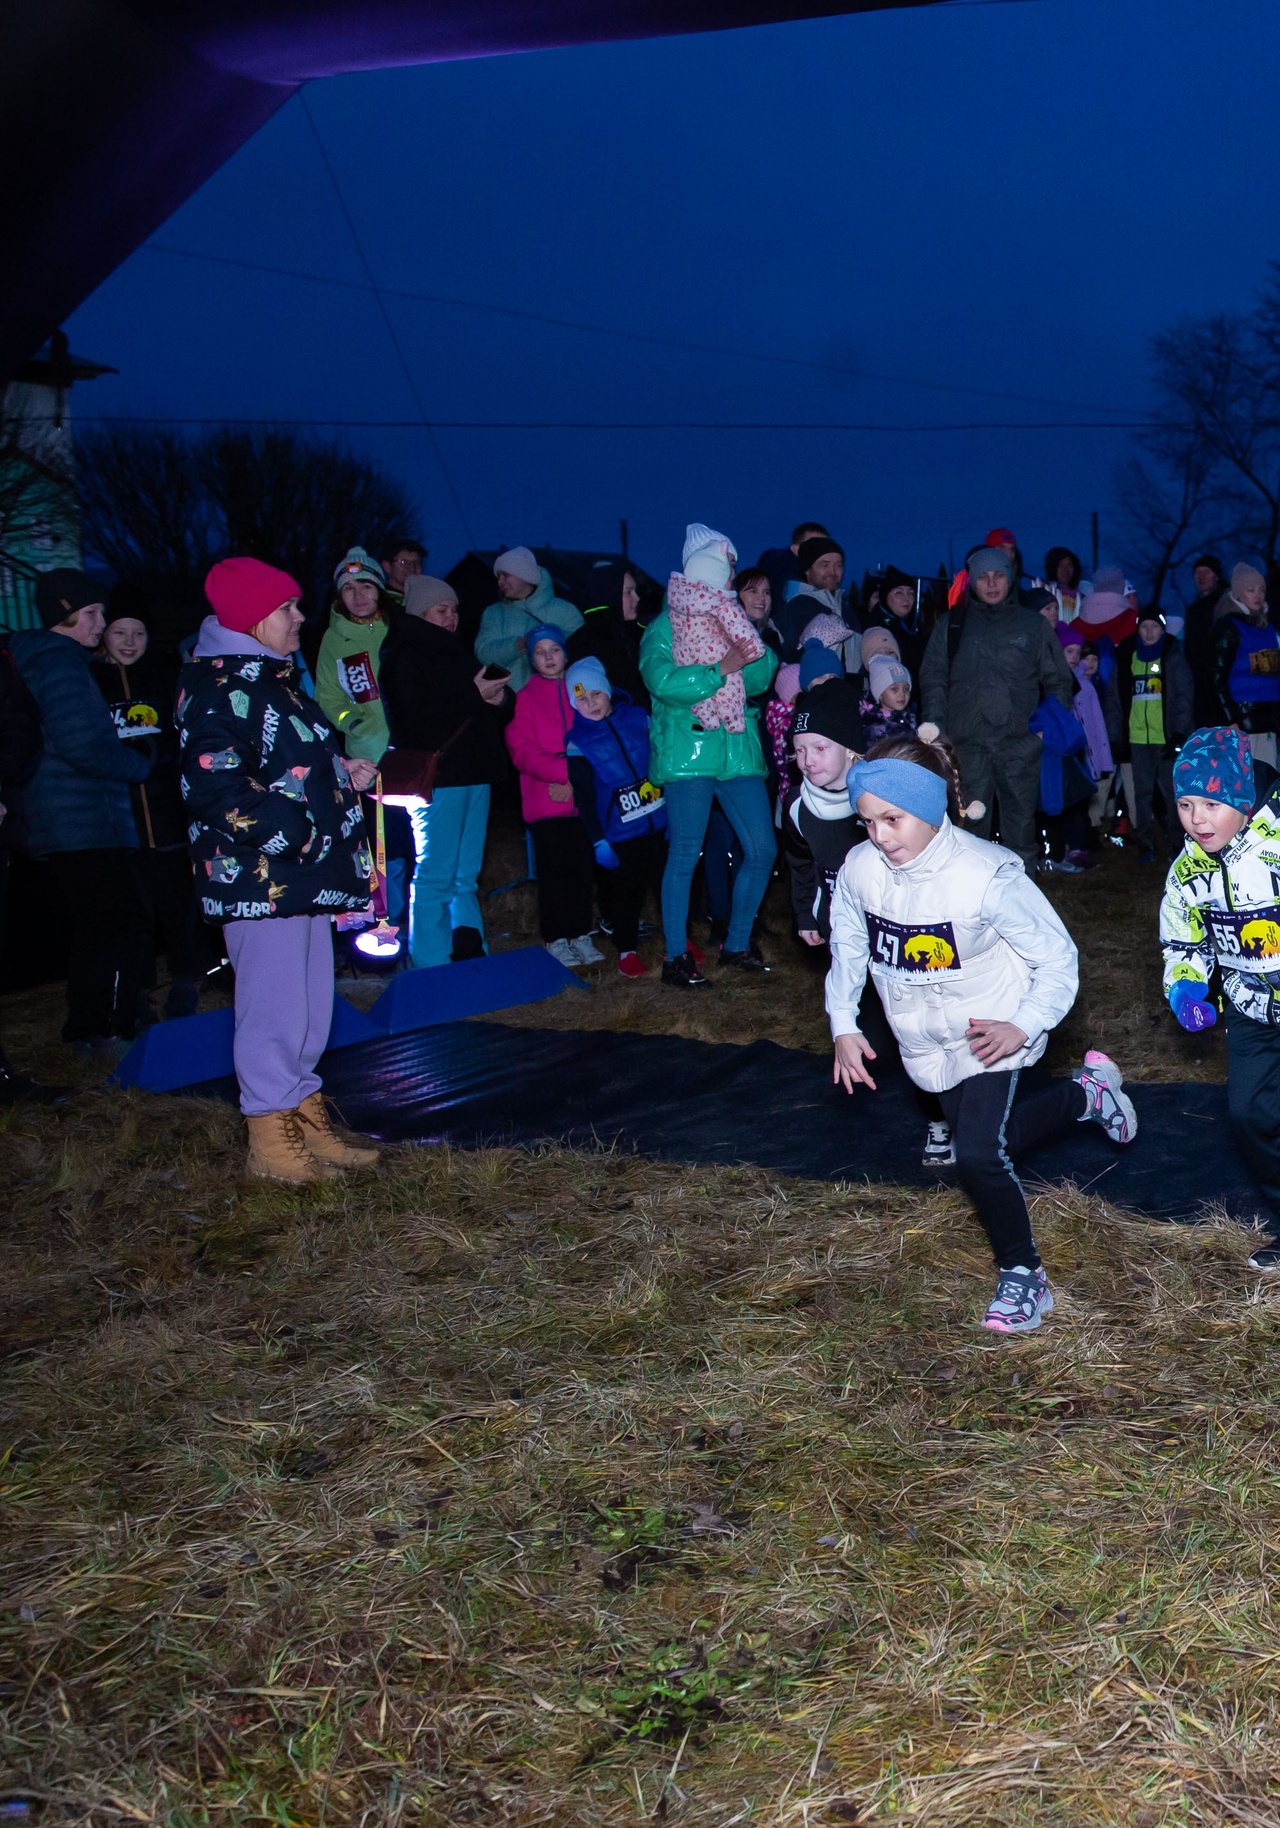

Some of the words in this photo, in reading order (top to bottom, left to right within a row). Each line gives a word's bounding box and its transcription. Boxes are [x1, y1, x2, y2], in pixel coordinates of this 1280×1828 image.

[347, 662, 371, 693] 335
[110, 708, 127, 727] 4
[262, 703, 281, 751] JERRY
[619, 790, 641, 811] 80
[201, 896, 223, 917] TOM
[231, 901, 272, 918] JERR
[876, 929, 900, 966] 47
[1211, 922, 1241, 955] 55
